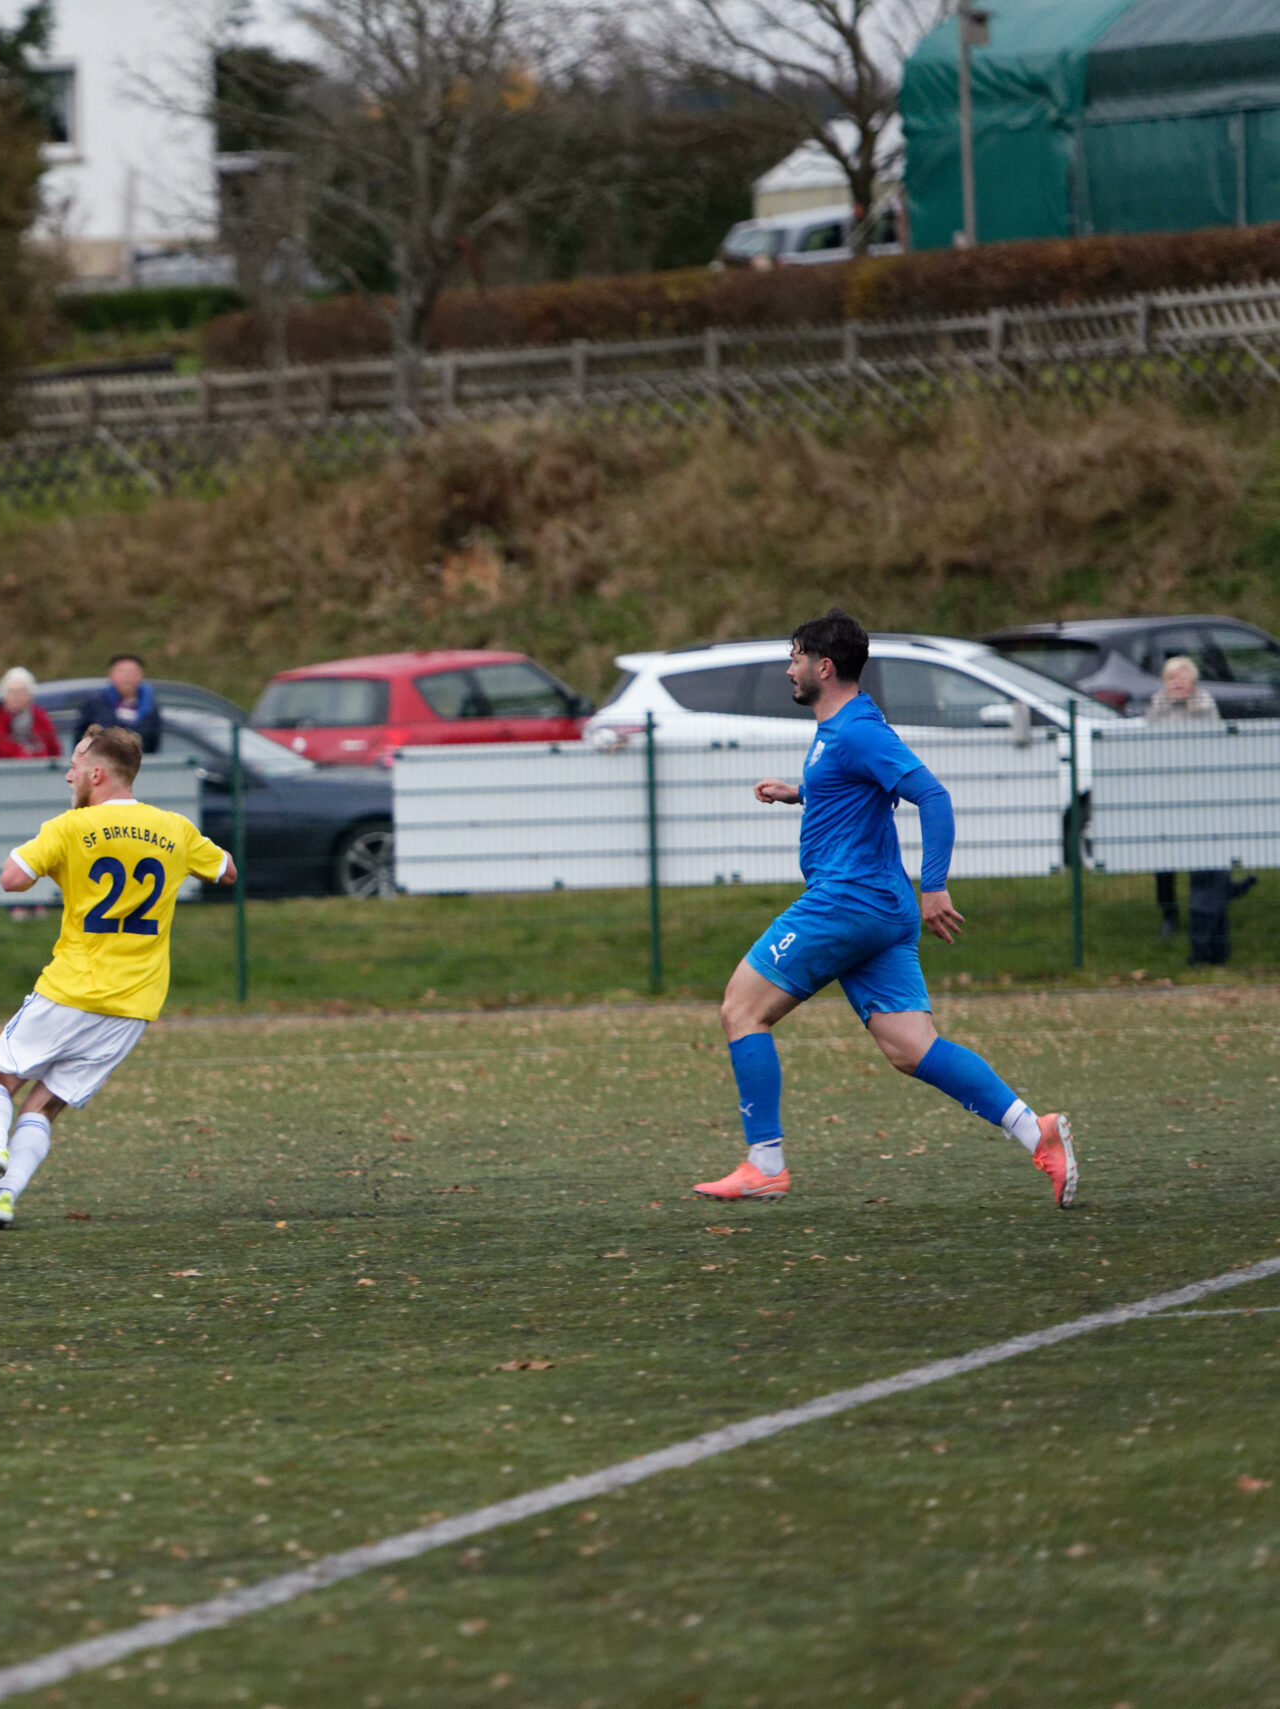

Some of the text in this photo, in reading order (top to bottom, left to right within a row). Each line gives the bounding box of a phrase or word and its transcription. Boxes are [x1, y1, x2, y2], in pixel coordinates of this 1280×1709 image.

[83, 826, 176, 854] SF BIRKELBACH
[84, 856, 166, 935] 22
[778, 932, 796, 950] 8
